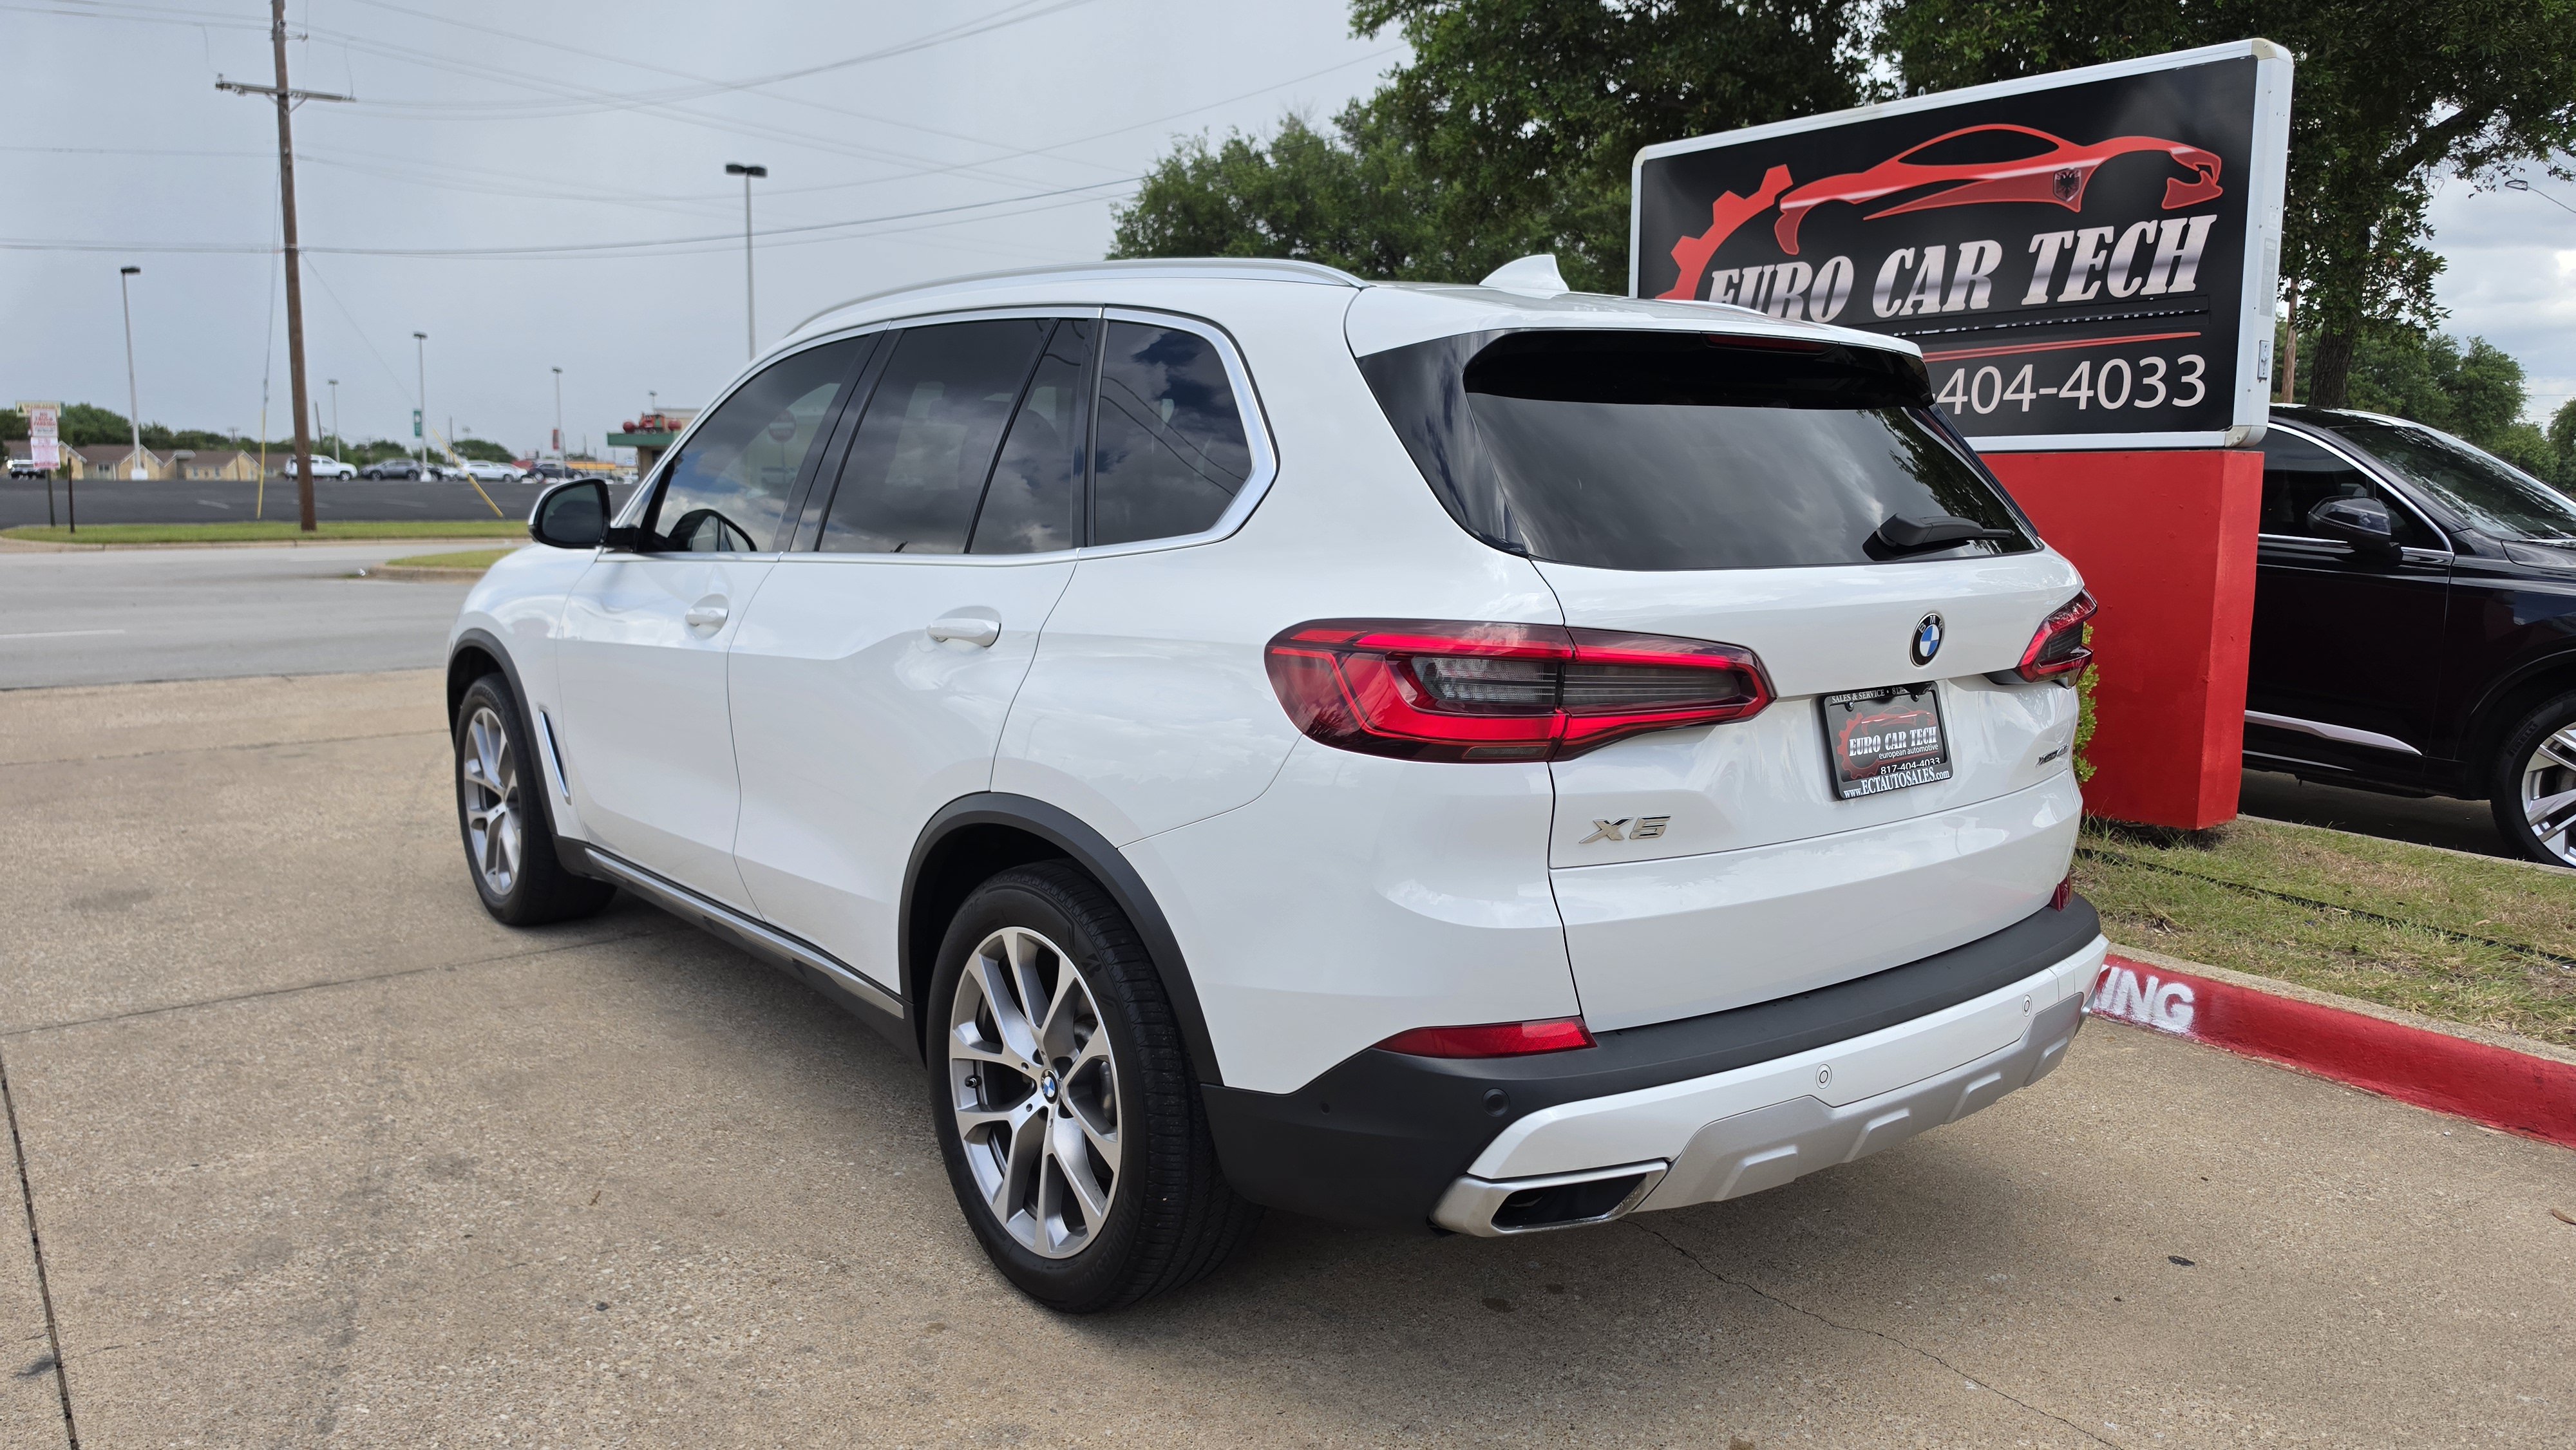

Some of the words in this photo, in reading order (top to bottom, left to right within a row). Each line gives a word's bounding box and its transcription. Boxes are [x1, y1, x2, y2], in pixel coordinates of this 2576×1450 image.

[1708, 256, 1855, 323] EURO
[1872, 239, 2003, 318] CAR
[2022, 214, 2217, 306] TECH
[1832, 693, 1851, 704] SALES
[1859, 689, 1885, 700] SERVICE
[1849, 735, 1881, 757] EURO
[1884, 731, 1907, 751] CAR
[1909, 726, 1937, 747] TECH
[1879, 749, 1907, 759] european
[1907, 744, 1938, 755] automotive
[1880, 757, 1940, 775] 817-404-4033
[1843, 766, 1950, 798] www.ECTAUTOSALES.com
[1578, 814, 1671, 843] X5
